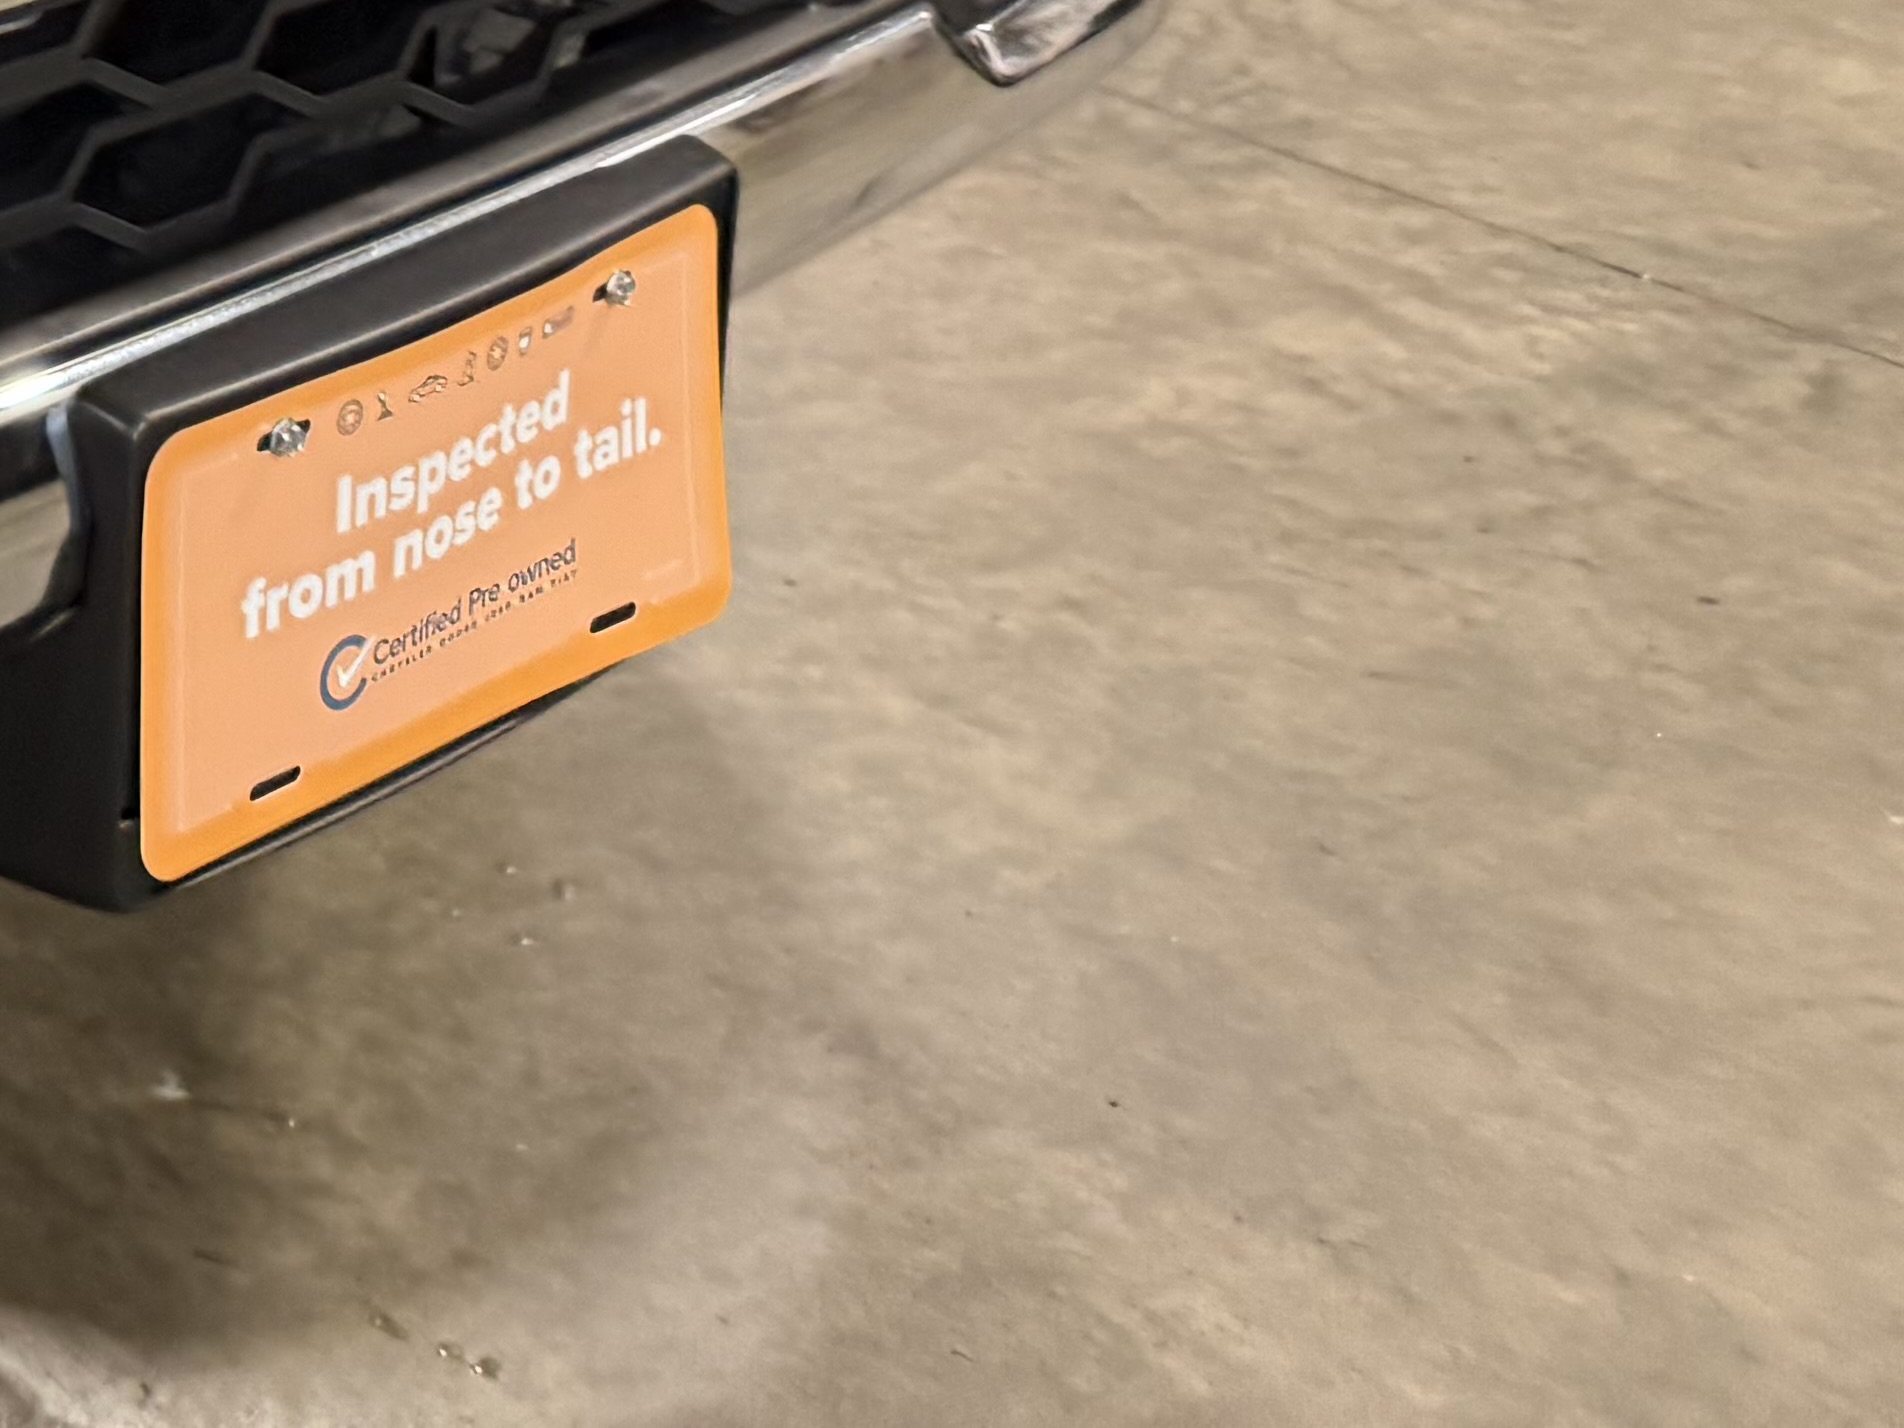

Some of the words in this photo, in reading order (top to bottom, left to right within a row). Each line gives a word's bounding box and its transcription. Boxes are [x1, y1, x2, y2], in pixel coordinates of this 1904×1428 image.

[240, 548, 376, 640] from
[393, 485, 504, 580] nose
[514, 454, 562, 511] to
[574, 396, 663, 480] tail.
[335, 368, 571, 535] Inspected
[373, 596, 462, 666] Certified
[507, 536, 577, 593] owned
